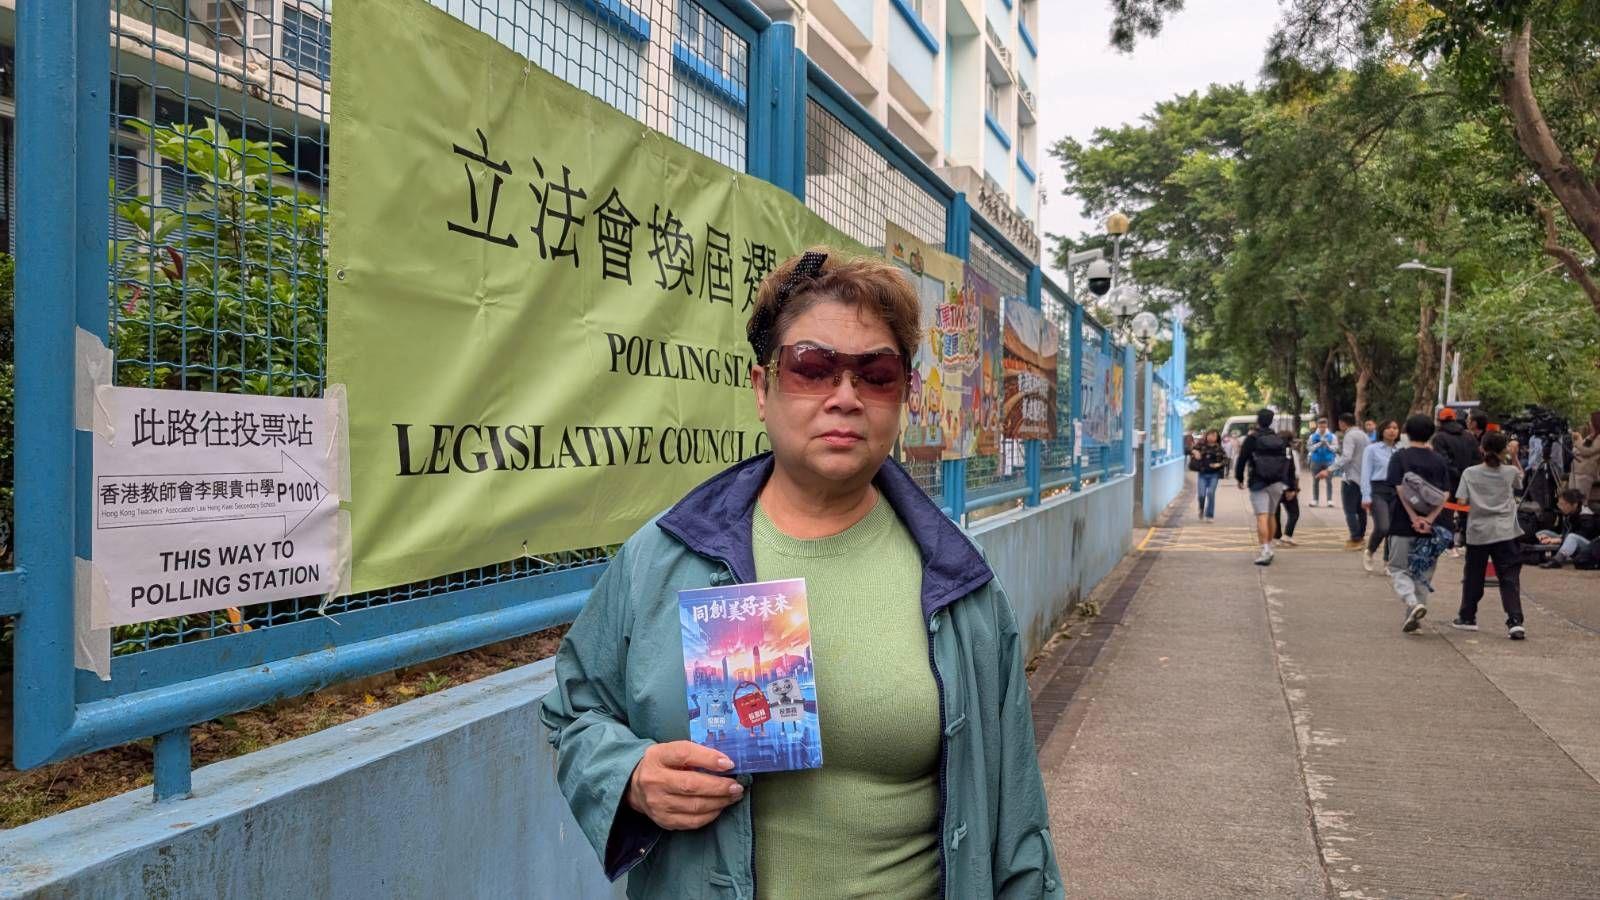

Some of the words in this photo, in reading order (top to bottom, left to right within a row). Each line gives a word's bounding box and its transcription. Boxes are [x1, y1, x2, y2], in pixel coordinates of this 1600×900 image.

[447, 128, 776, 312] 立法會換屆選
[604, 332, 722, 384] POLLING
[724, 352, 754, 390] STA
[132, 408, 313, 447] 此路往投票站
[391, 424, 654, 477] LEGISLATIVE
[659, 426, 752, 465] COUNCIL
[100, 479, 275, 505] 香港教師會李興貴中學
[278, 481, 319, 503] P1001
[120, 509, 135, 517] Kong
[160, 548, 211, 572] THIS
[218, 543, 266, 566] WAY
[271, 540, 294, 559] TO
[131, 576, 231, 608] POLLING
[237, 564, 320, 593] STATION
[692, 593, 793, 623] 同創美好未來
